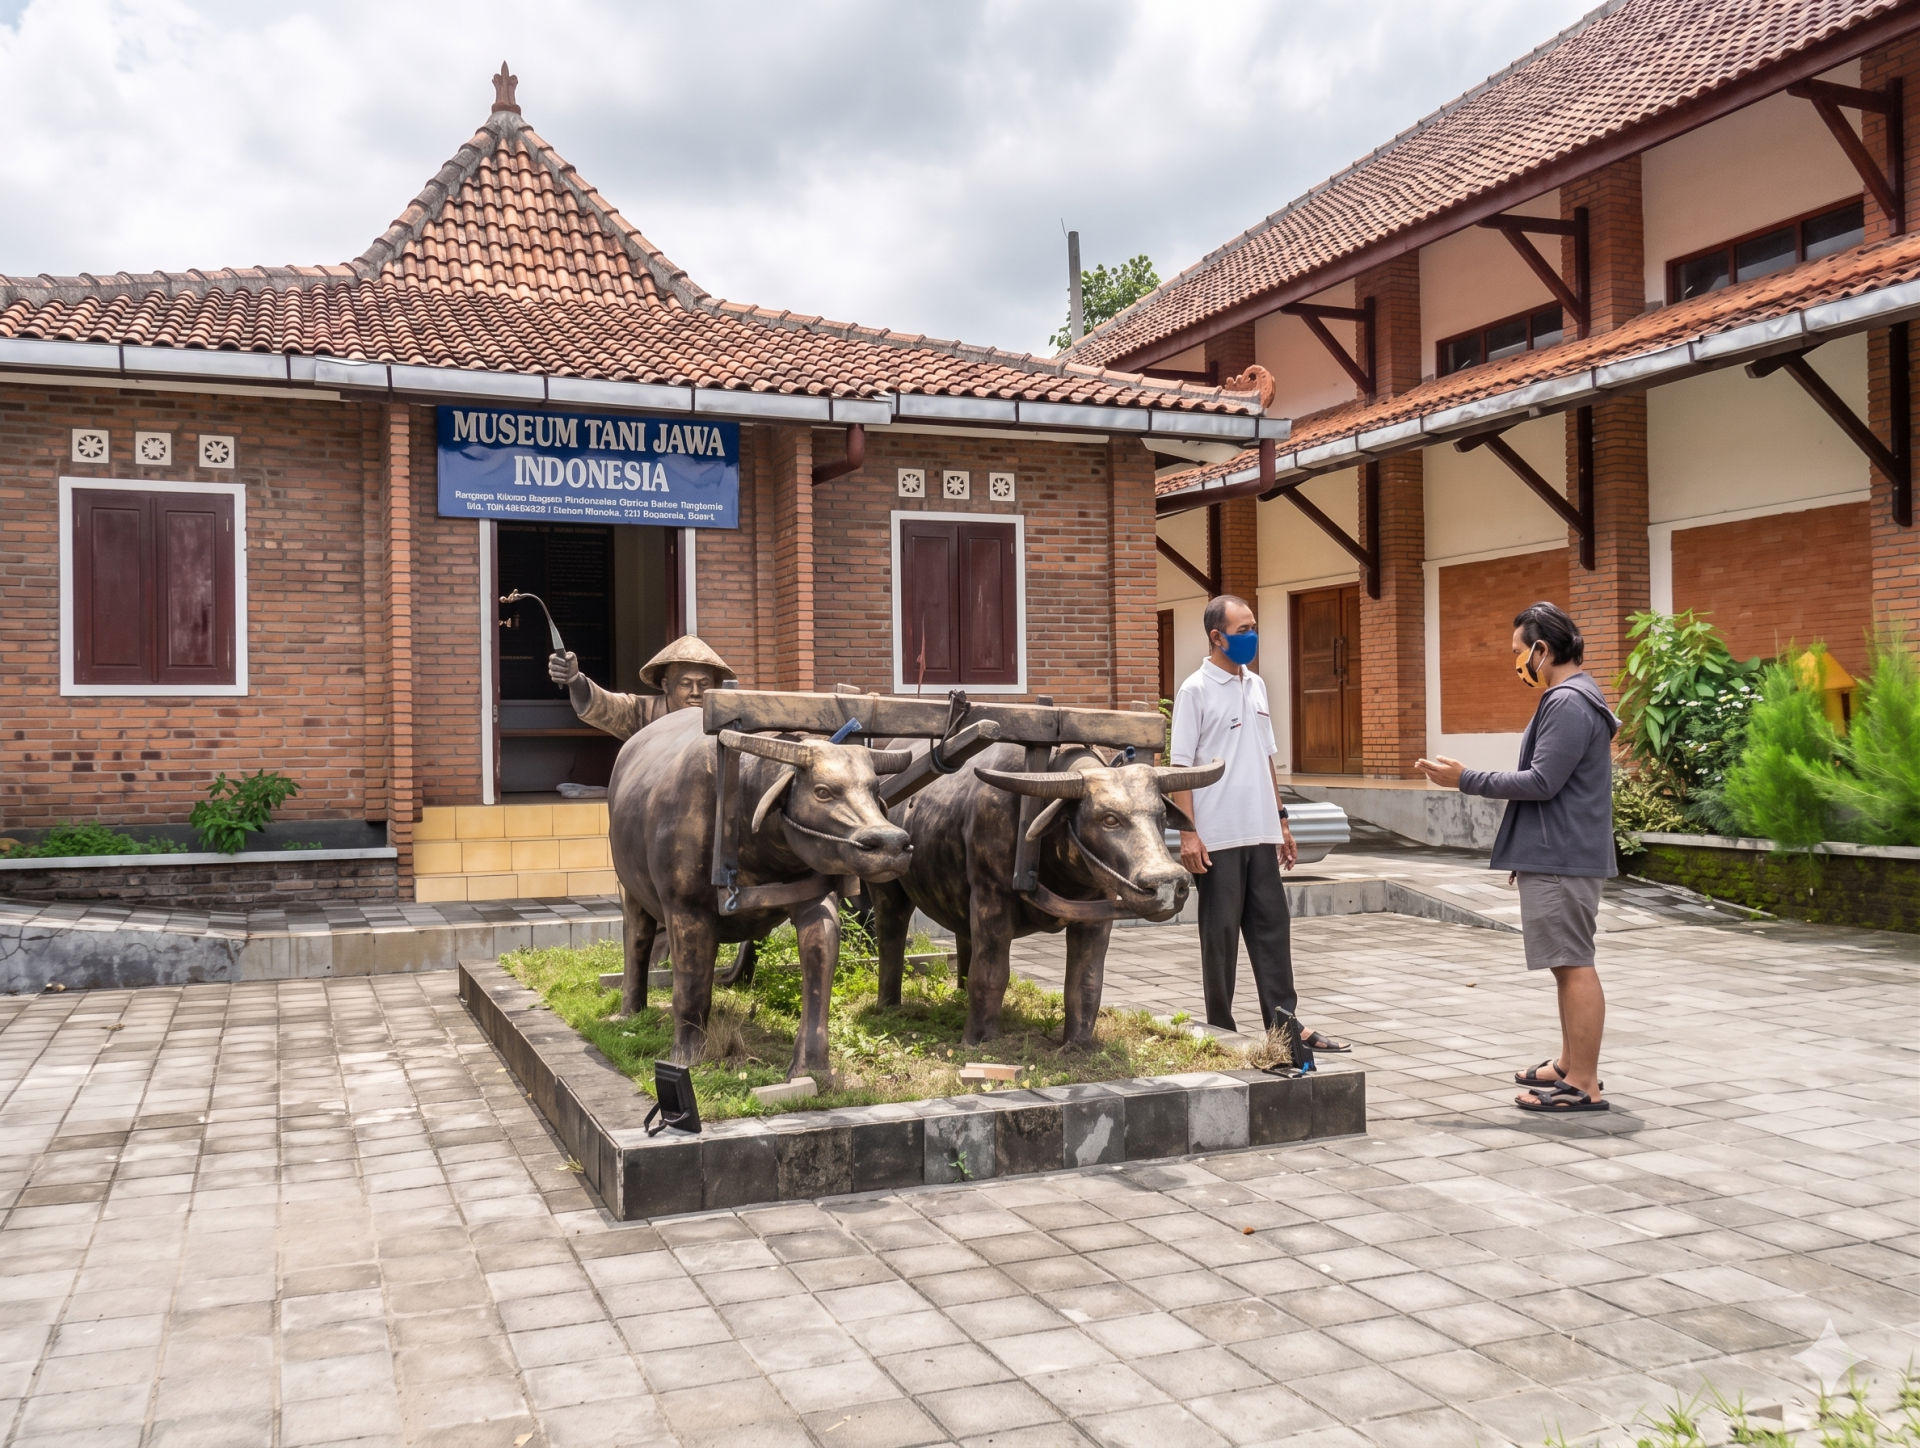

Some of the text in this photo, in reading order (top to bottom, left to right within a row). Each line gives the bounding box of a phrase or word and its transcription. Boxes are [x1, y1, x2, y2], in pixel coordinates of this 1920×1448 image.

[452, 410, 726, 457] MUSEUM TANI JAWA
[513, 455, 670, 492] INDONESIA
